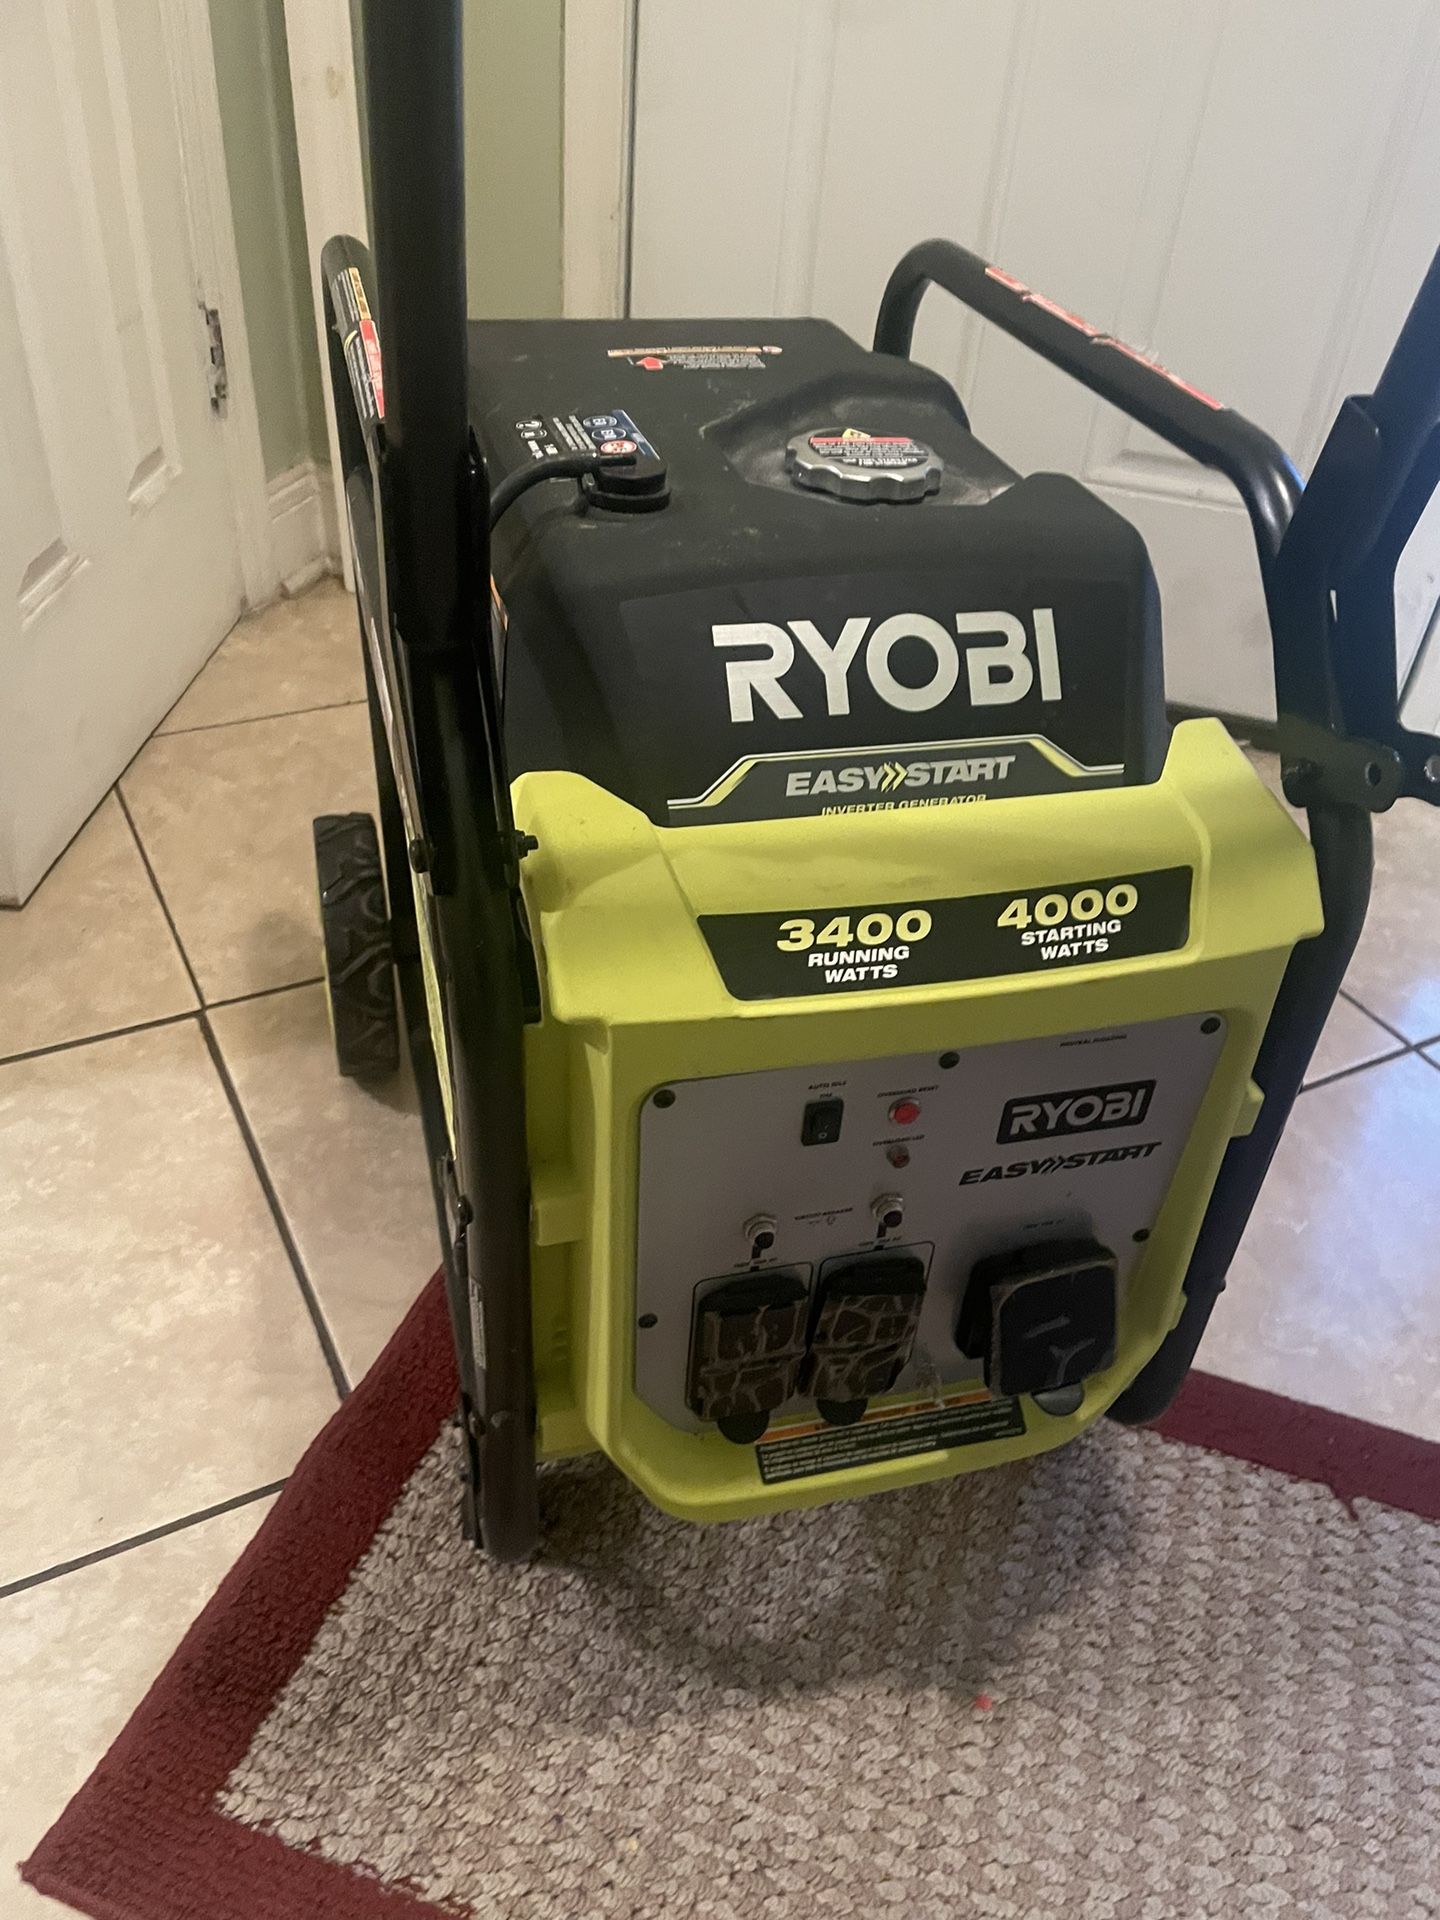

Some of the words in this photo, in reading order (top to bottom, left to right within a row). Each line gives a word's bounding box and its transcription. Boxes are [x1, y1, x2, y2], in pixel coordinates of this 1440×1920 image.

[711, 608, 1063, 723] RYOBI
[786, 766, 886, 797] EASY
[904, 755, 1017, 788] START
[996, 883, 1139, 930] 4000
[776, 909, 933, 952] 3400
[1020, 918, 1122, 947] STARTING
[1041, 938, 1110, 961] WATTS
[807, 945, 910, 968] RUNNING
[824, 964, 899, 984] WATTS
[1009, 1087, 1147, 1136] RYOBI
[958, 1157, 1051, 1186] EASY
[1062, 1142, 1163, 1170] START
